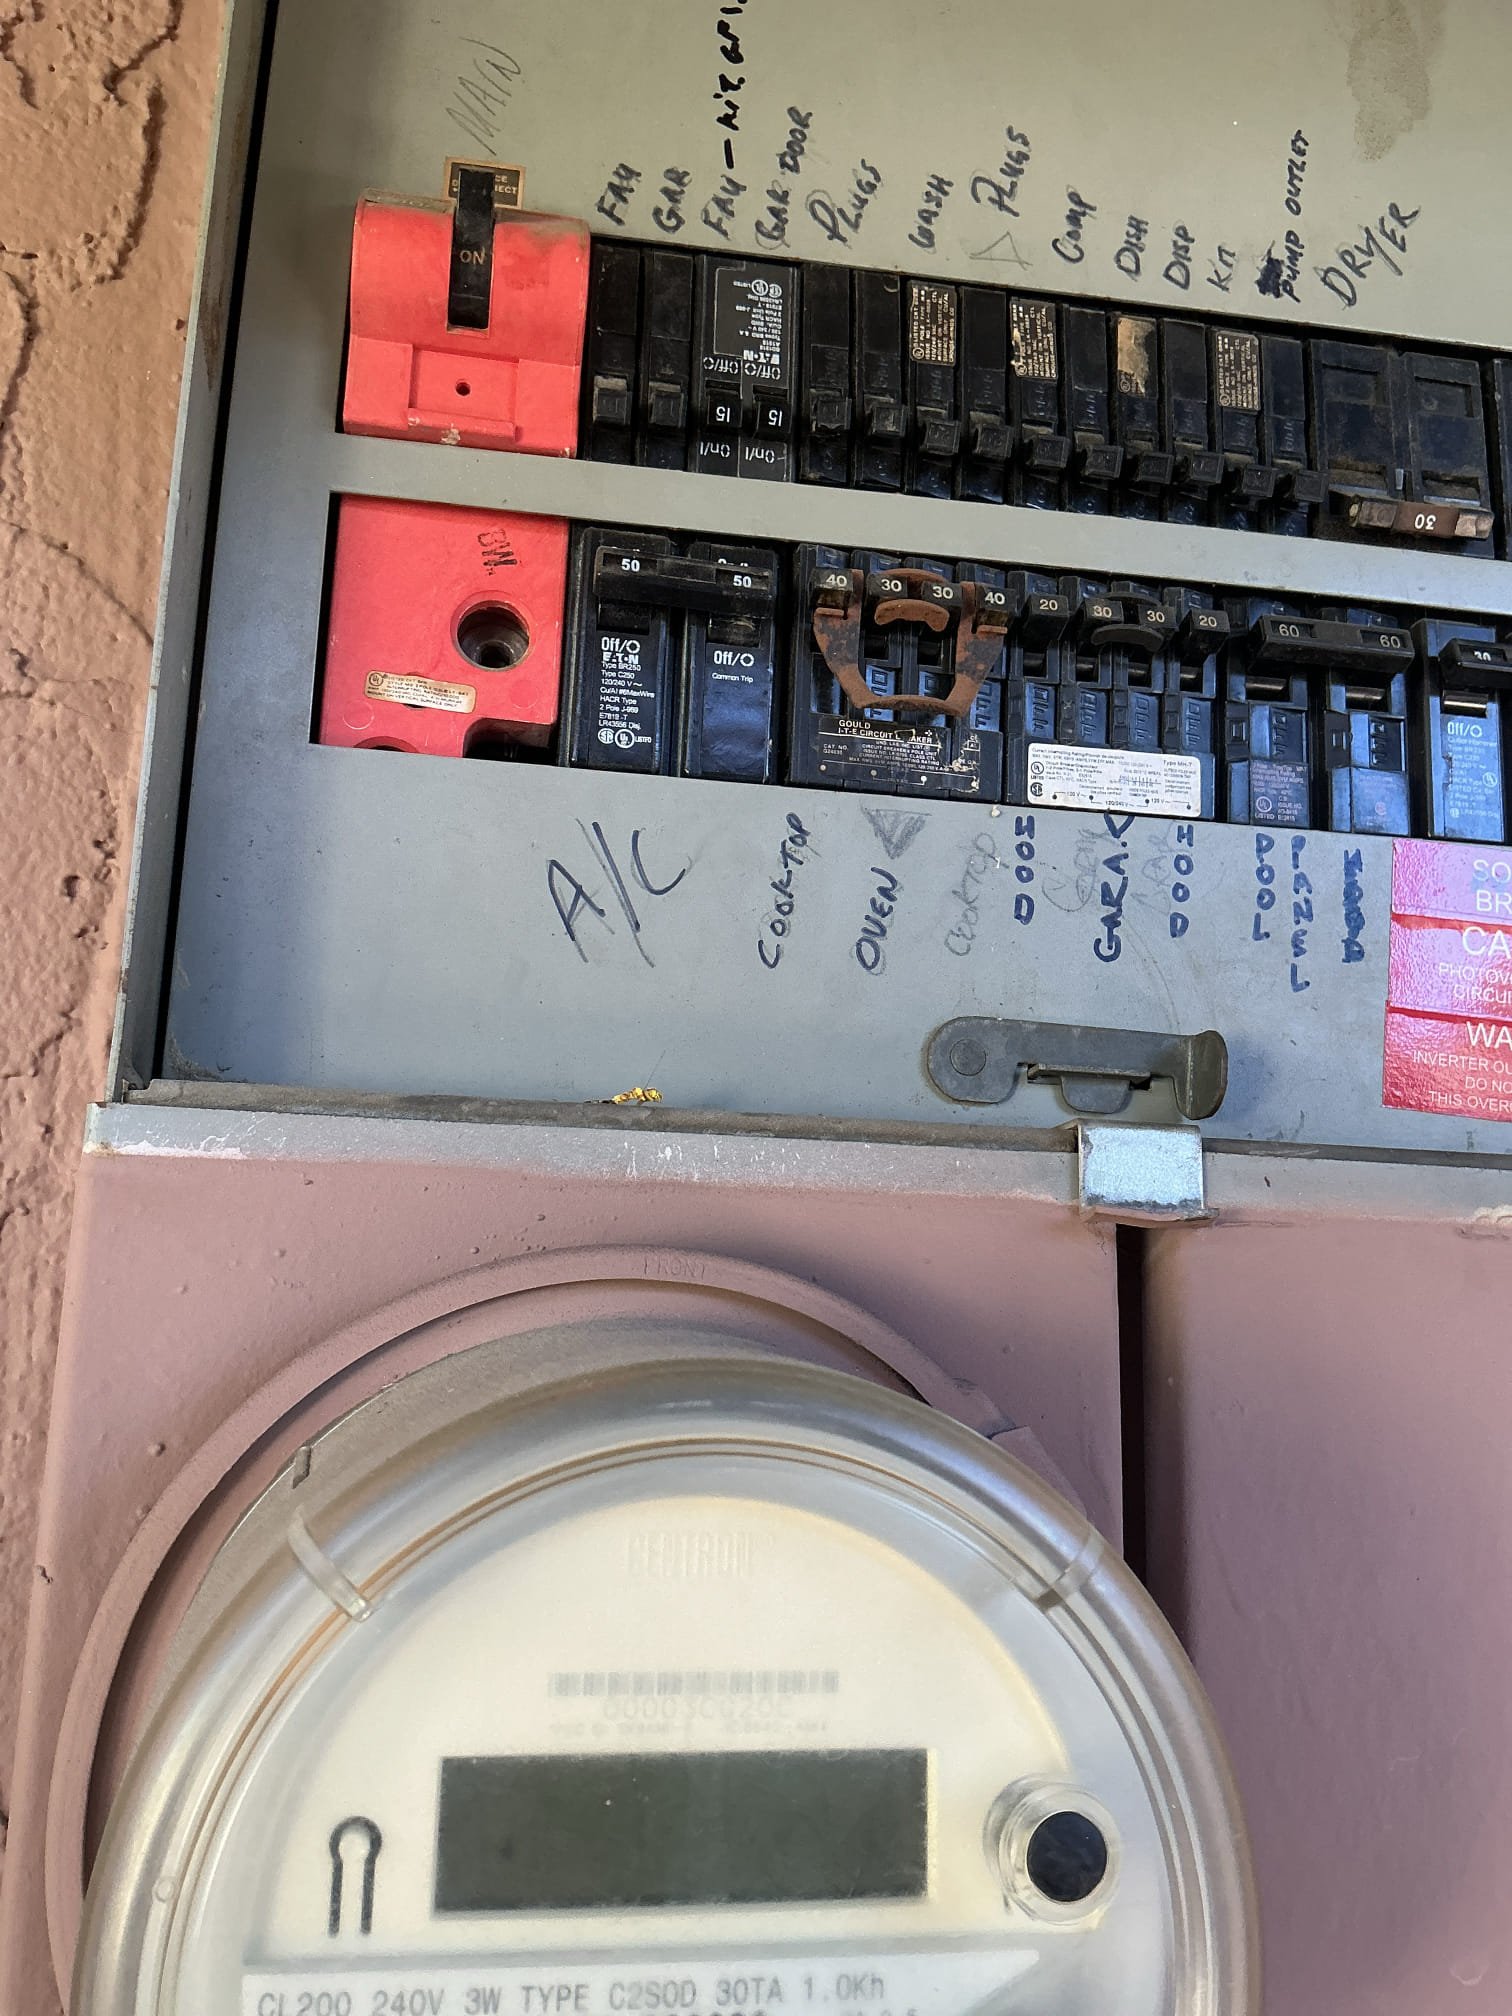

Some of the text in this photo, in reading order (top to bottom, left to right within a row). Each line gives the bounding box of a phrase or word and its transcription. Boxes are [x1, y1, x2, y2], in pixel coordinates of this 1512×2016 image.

[970, 125, 1032, 217] PLUGS
[1285, 129, 1309, 216] OUTLET
[808, 158, 883, 245] PLUGS
[908, 174, 954, 252] WASH
[460, 249, 485, 265] ON
[1318, 202, 1421, 308] DRYER
[716, 406, 730, 422] 15
[769, 410, 782, 426] 15
[1414, 513, 1437, 530] 30
[622, 559, 640, 571] 50
[733, 575, 751, 587] 50
[826, 574, 847, 587] 40
[881, 579, 902, 592] 30
[933, 586, 953, 599] 30
[985, 592, 1005, 605] 40
[1040, 600, 1058, 611] 20
[1093, 606, 1112, 617] 30
[1147, 611, 1165, 623] 30
[1200, 616, 1217, 627] 20
[1278, 624, 1299, 637] 60
[1380, 635, 1401, 648] 60
[839, 720, 871, 730] GOULD
[860, 730, 892, 739] CIRCUIT
[854, 866, 902, 974] OVEN
[1413, 1050, 1489, 1073] INVERTER
[1465, 1076, 1488, 1091] DO
[1428, 1091, 1463, 1107] THIS
[371, 1988, 445, 2016] 240V
[464, 1985, 502, 2014] 3W
[522, 1983, 590, 2012] TYPE
[715, 1976, 784, 2007] 30TA
